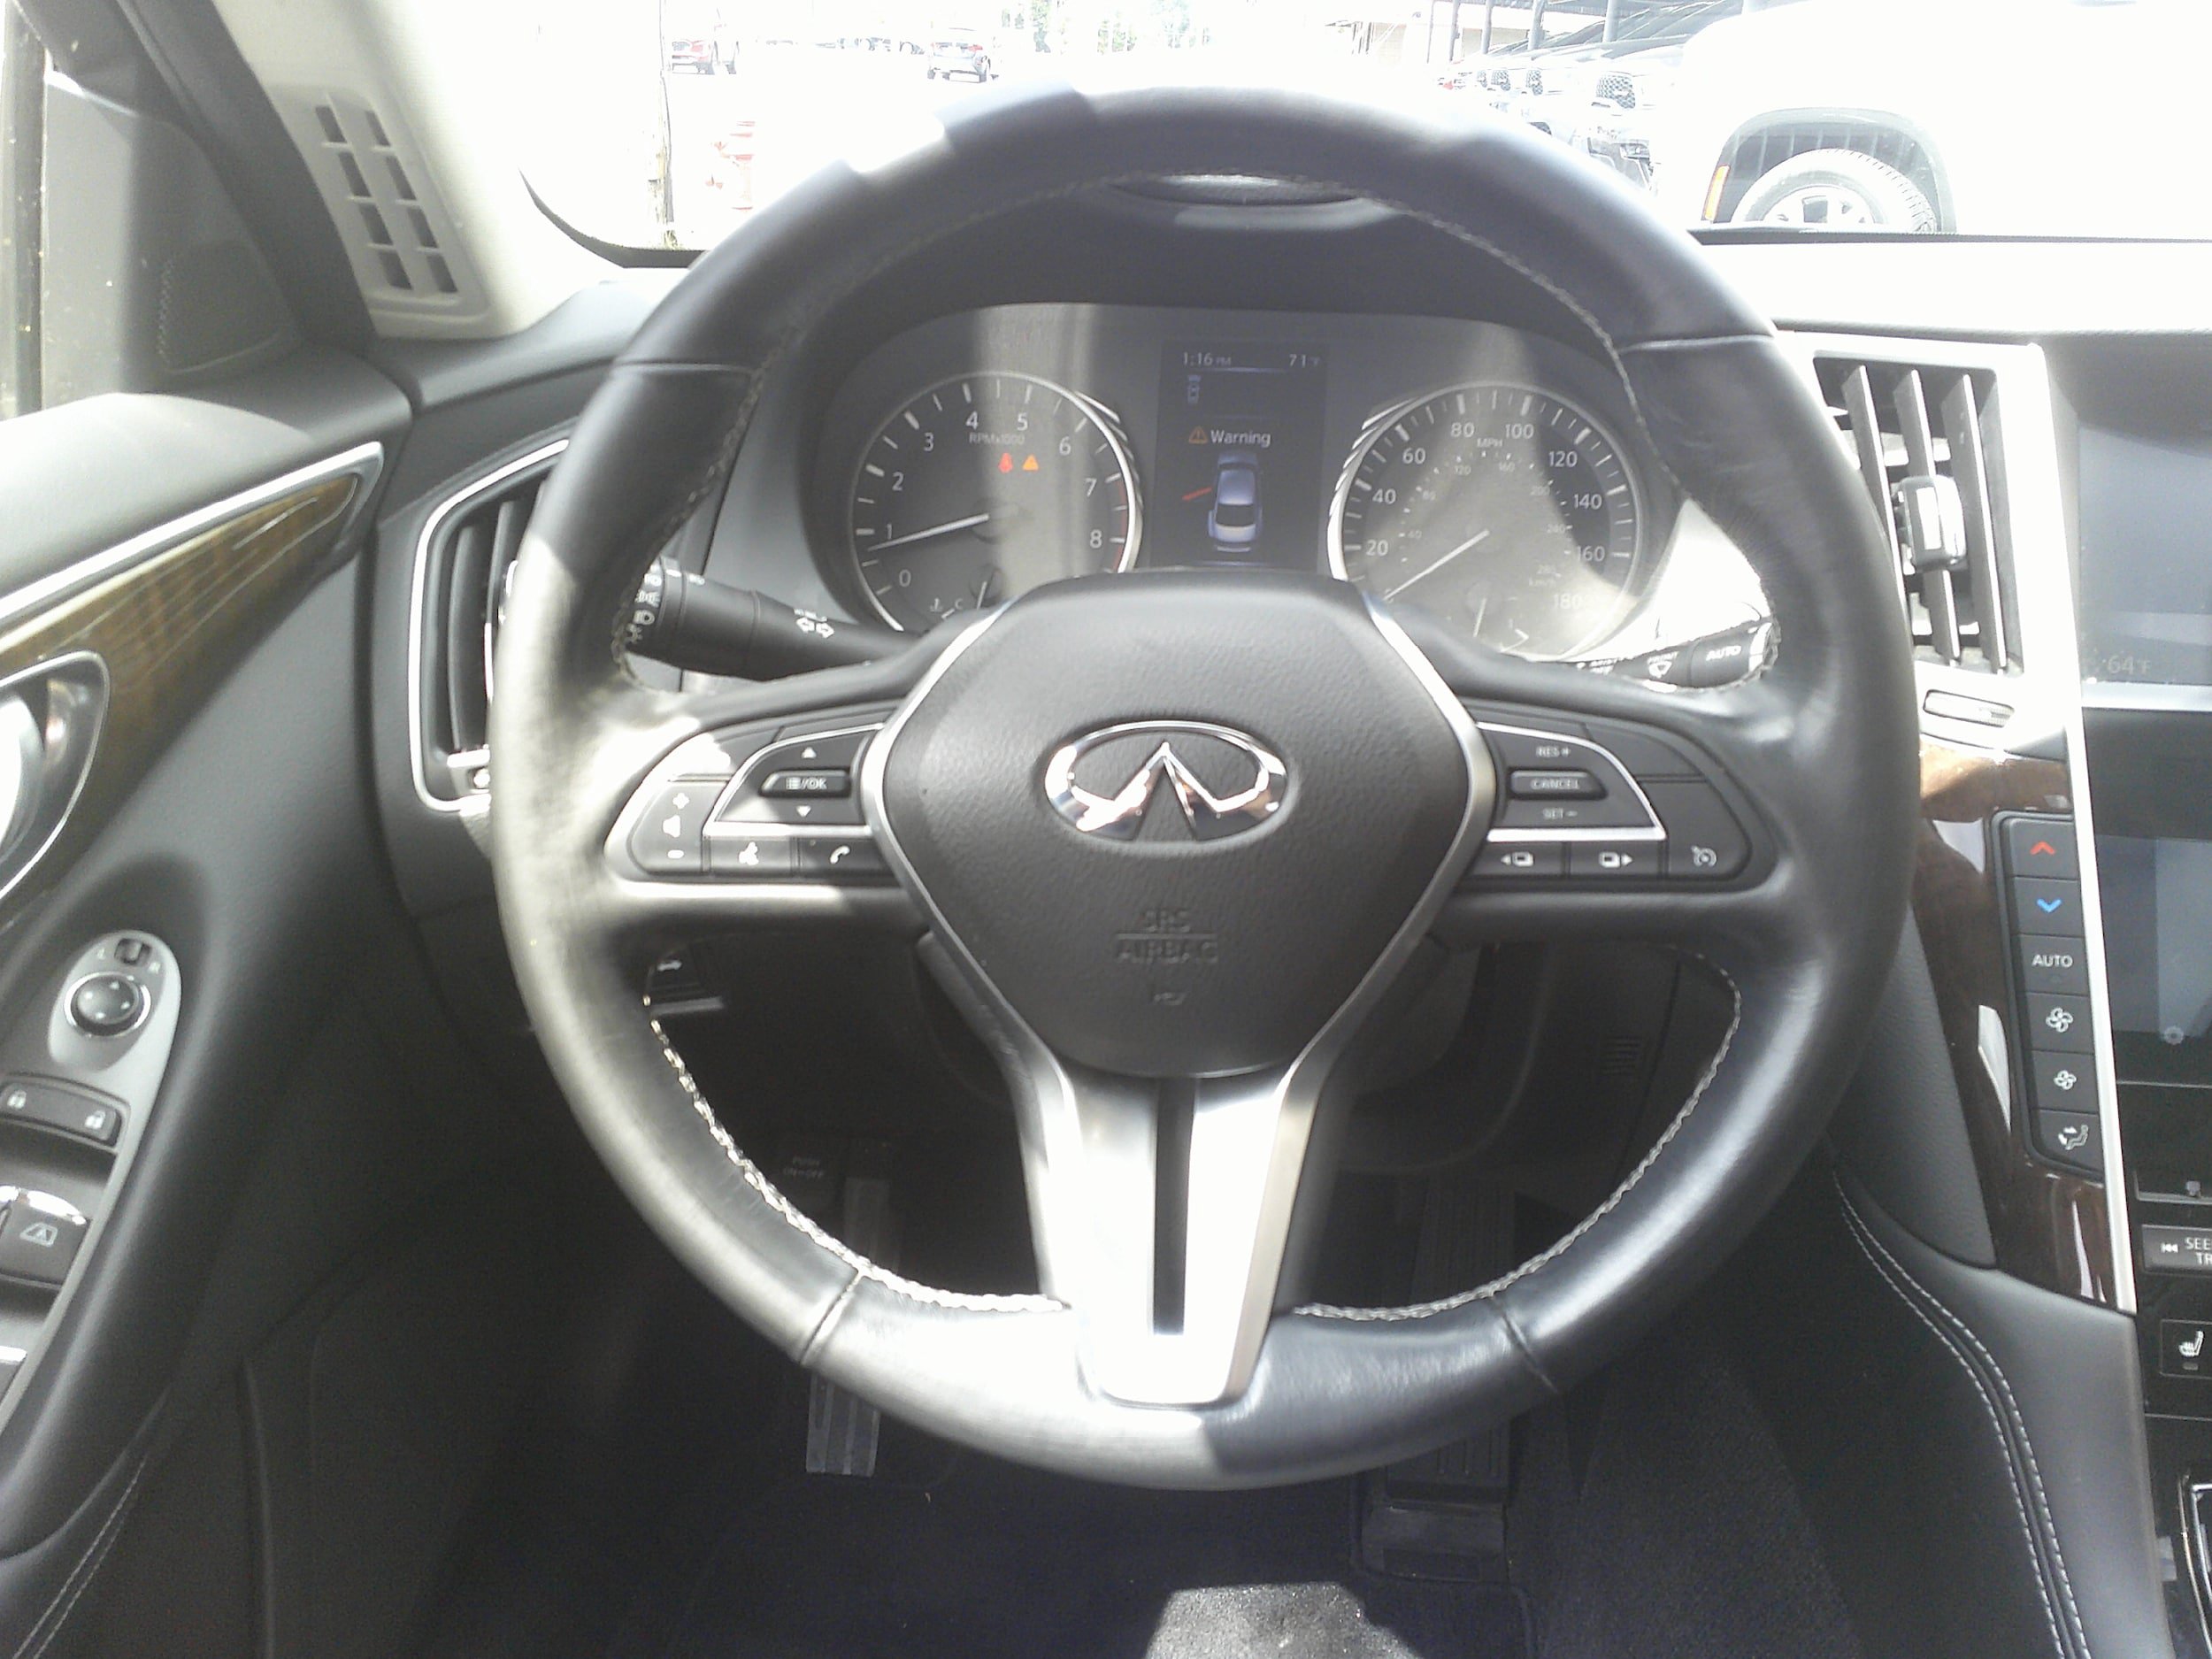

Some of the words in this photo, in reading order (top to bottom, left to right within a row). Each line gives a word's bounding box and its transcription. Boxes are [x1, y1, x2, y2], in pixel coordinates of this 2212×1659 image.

[1183, 351, 1213, 366] 1:16
[966, 411, 979, 430] 4
[1017, 412, 1028, 431] 5
[1450, 421, 1475, 438] 80
[1505, 423, 1534, 440] 100
[924, 432, 934, 451] 3
[1059, 436, 1071, 456] 6
[1210, 429, 1271, 449] Warning
[1476, 437, 1503, 448] MPH
[1402, 448, 1426, 465] 60
[1548, 450, 1578, 468] 120
[892, 472, 904, 491] 2
[1085, 477, 1097, 497] 7
[1372, 488, 1396, 504] 40
[1573, 493, 1602, 510] 140
[1089, 529, 1102, 549] 8
[1366, 540, 1388, 557] 20
[1578, 545, 1606, 562] 160
[899, 570, 911, 588] 0
[1554, 593, 1584, 610] 180
[1706, 644, 1742, 662] AUTO
[1531, 777, 1580, 790] CANCEL
[2032, 954, 2073, 968] AUTO
